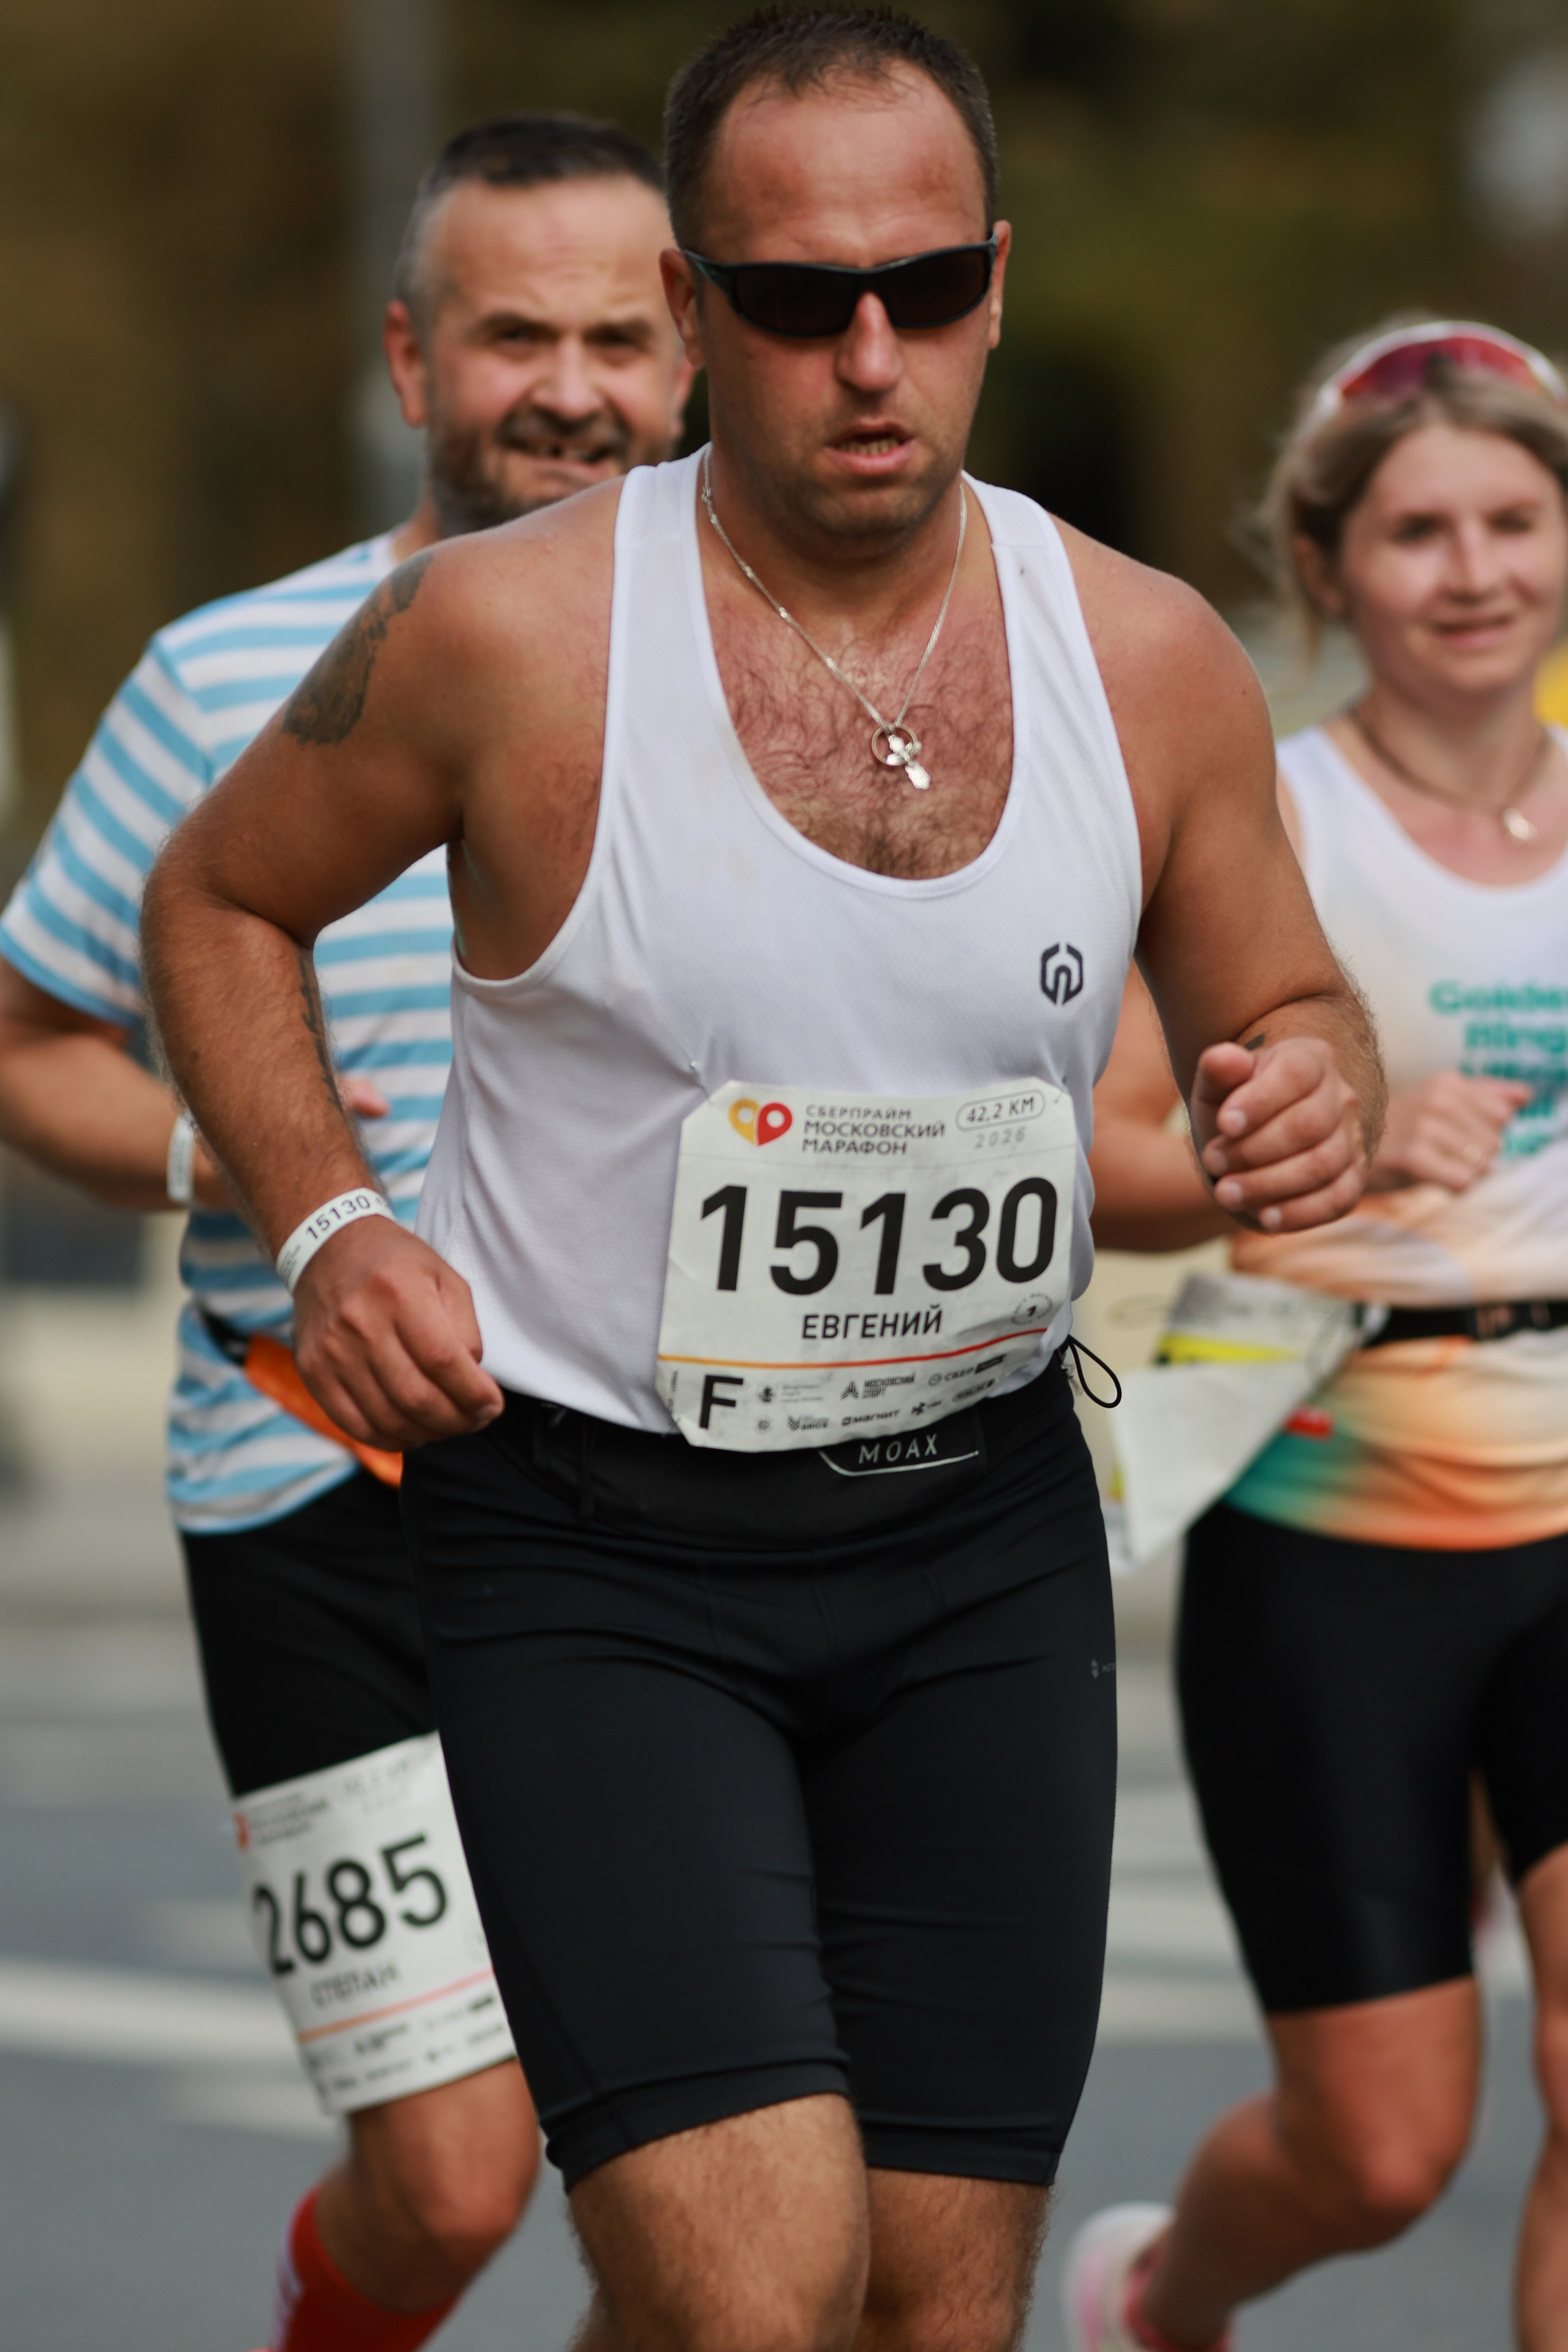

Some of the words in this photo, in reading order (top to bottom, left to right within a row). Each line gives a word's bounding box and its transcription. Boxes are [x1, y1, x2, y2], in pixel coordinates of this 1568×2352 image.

[805, 1104, 912, 1120] СБЕРПРАЙМ
[966, 1102, 1003, 1122] 42,2
[804, 1119, 946, 1139] МОСКОВСКИЙ
[974, 1126, 1026, 1149] 2026
[802, 1139, 908, 1156] МАРАФОН
[306, 1195, 371, 1240] 15130
[700, 1175, 1058, 1297] 15130
[801, 1303, 943, 1340] ЕВГЕНИЙ
[699, 1374, 744, 1430] F
[859, 1433, 938, 1464] MOAX
[252, 1832, 448, 1975] 2685
